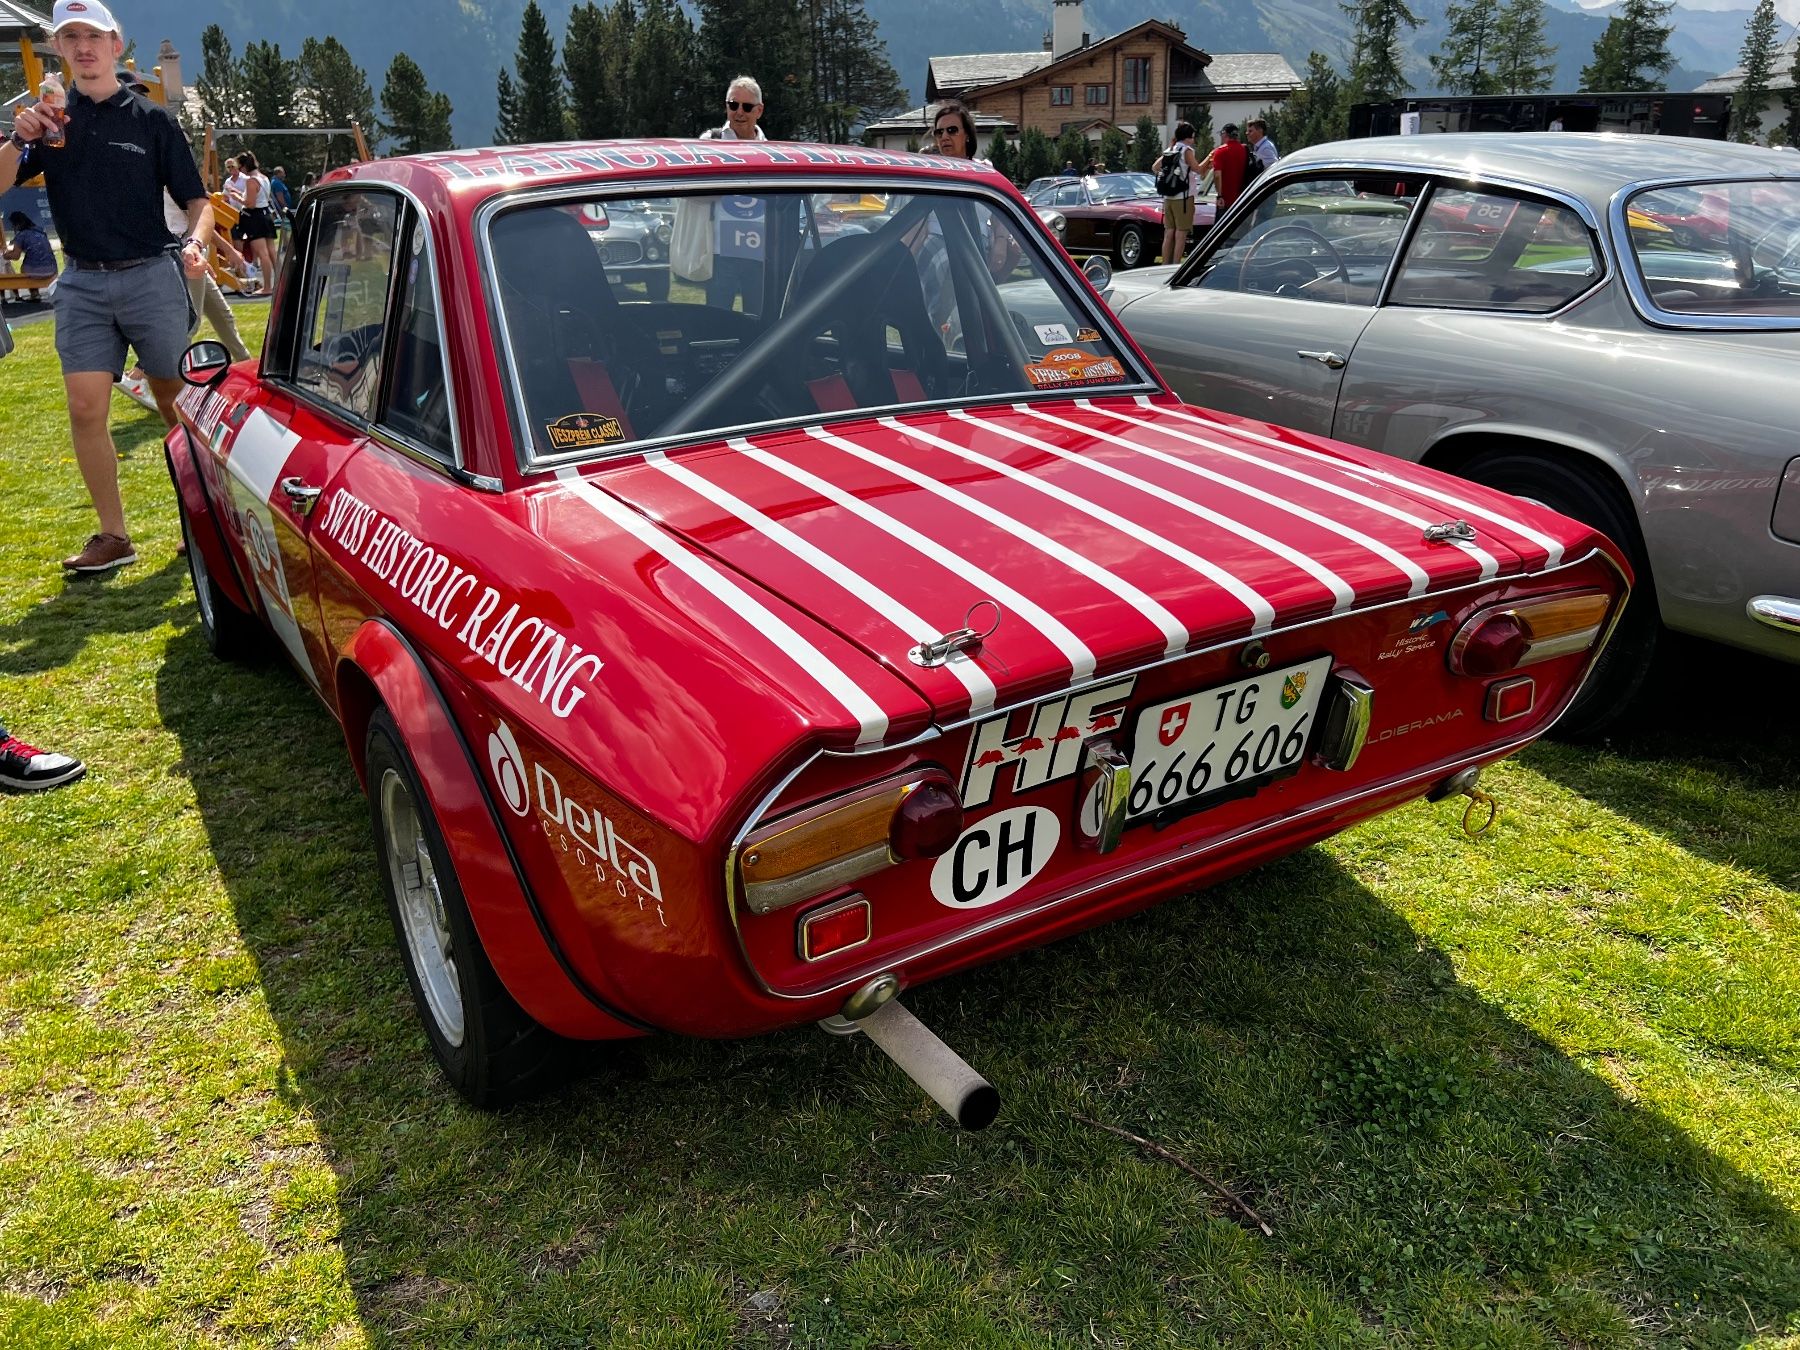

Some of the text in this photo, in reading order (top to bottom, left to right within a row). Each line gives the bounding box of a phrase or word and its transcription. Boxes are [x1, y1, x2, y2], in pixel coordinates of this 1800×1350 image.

[437, 144, 746, 180] LANCIA
[1028, 360, 1120, 383] YPRES HISTORIC
[1053, 353, 1081, 361] 2008
[591, 420, 620, 438] CLASSIC
[319, 487, 605, 718] SWISS HISTORIC RACING
[1378, 641, 1436, 661] Rally Service
[1395, 634, 1428, 647] Historic
[1215, 683, 1260, 732] TG
[1362, 708, 1464, 745] LDIERAMA
[959, 674, 1138, 810] HF
[1127, 742, 1216, 815] 666
[1224, 712, 1309, 783] 606
[535, 762, 663, 902] Delta
[543, 820, 668, 927] csoport
[952, 811, 1037, 903] CH
